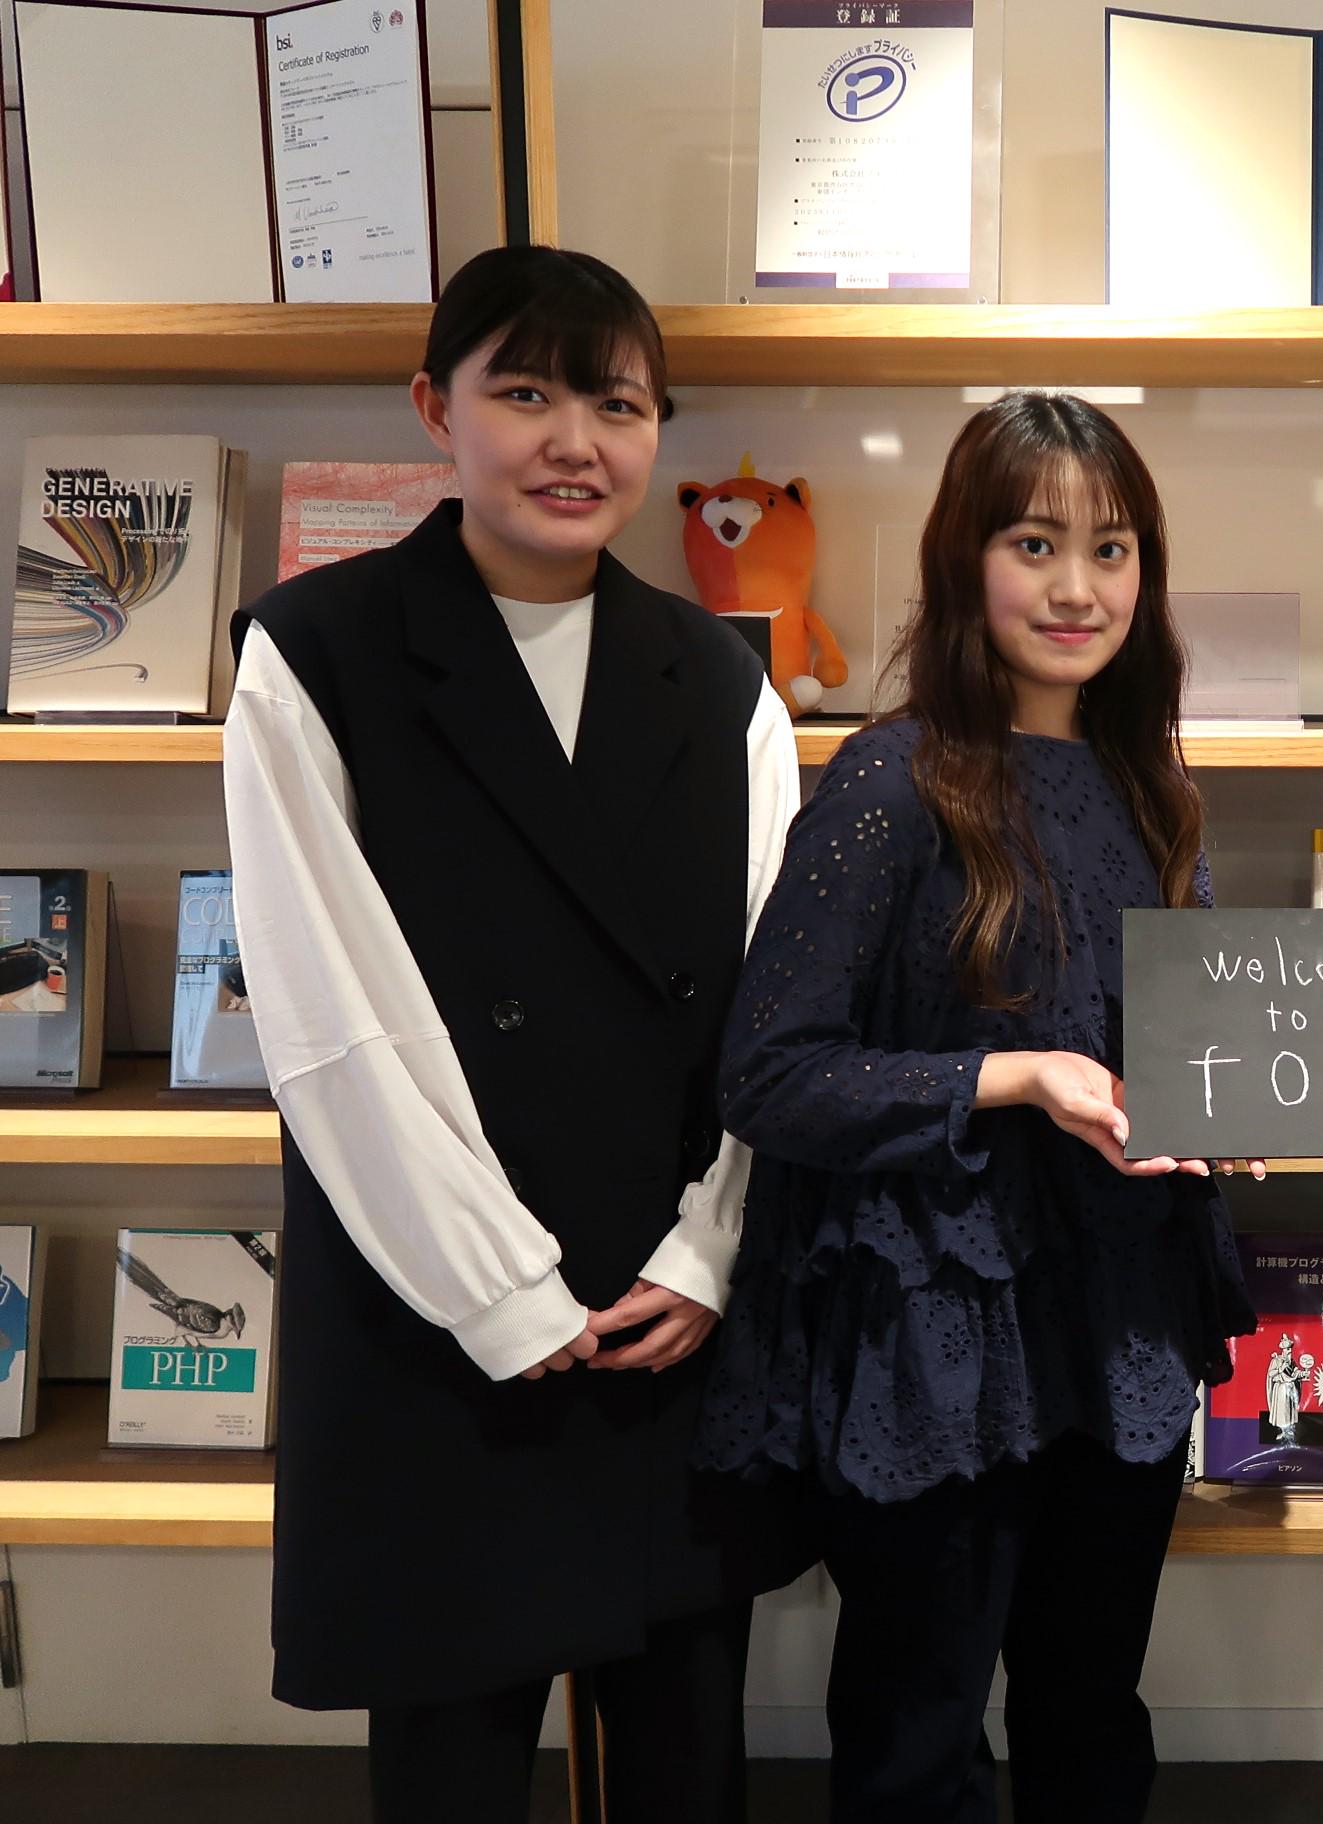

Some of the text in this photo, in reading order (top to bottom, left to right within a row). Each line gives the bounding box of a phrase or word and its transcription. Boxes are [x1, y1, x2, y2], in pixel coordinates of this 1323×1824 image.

[836, 9, 901, 24] 登録証
[278, 44, 370, 72] Certificate of Registration
[41, 477, 194, 497] GENERATIVE
[40, 499, 131, 519] DESIGN
[302, 503, 394, 515] Visual Complexity
[1266, 1000, 1307, 1032] to
[123, 1335, 177, 1347] プログラミング
[149, 1350, 228, 1386] PHP
